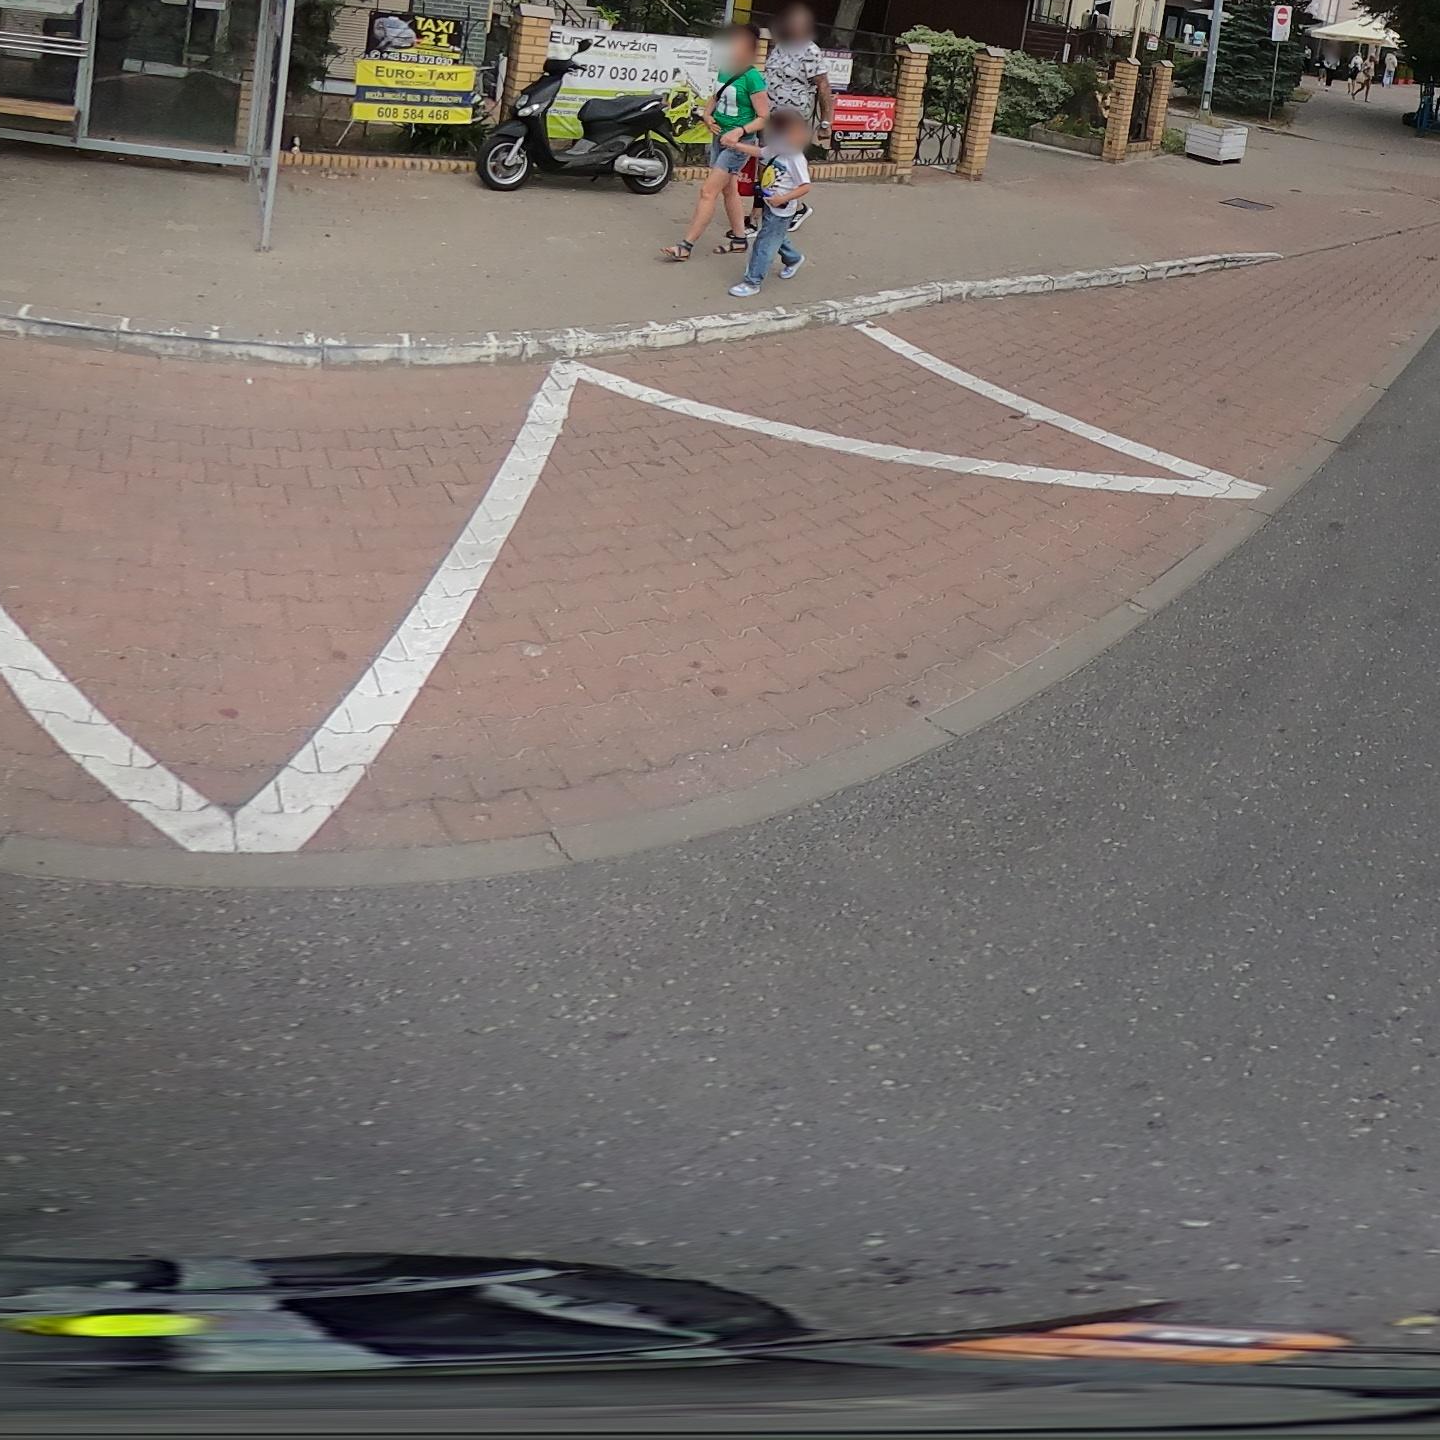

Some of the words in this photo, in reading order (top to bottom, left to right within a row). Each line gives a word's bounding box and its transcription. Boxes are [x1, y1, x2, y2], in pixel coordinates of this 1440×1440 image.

[414, 16, 455, 34] TAXI
[420, 31, 450, 47] 21
[580, 64, 606, 78] 787
[609, 66, 638, 80] 030
[641, 68, 669, 82] 240
[831, 60, 849, 73] TAXI
[377, 107, 399, 118] 608
[402, 108, 424, 120] 584
[428, 109, 450, 121] 468
